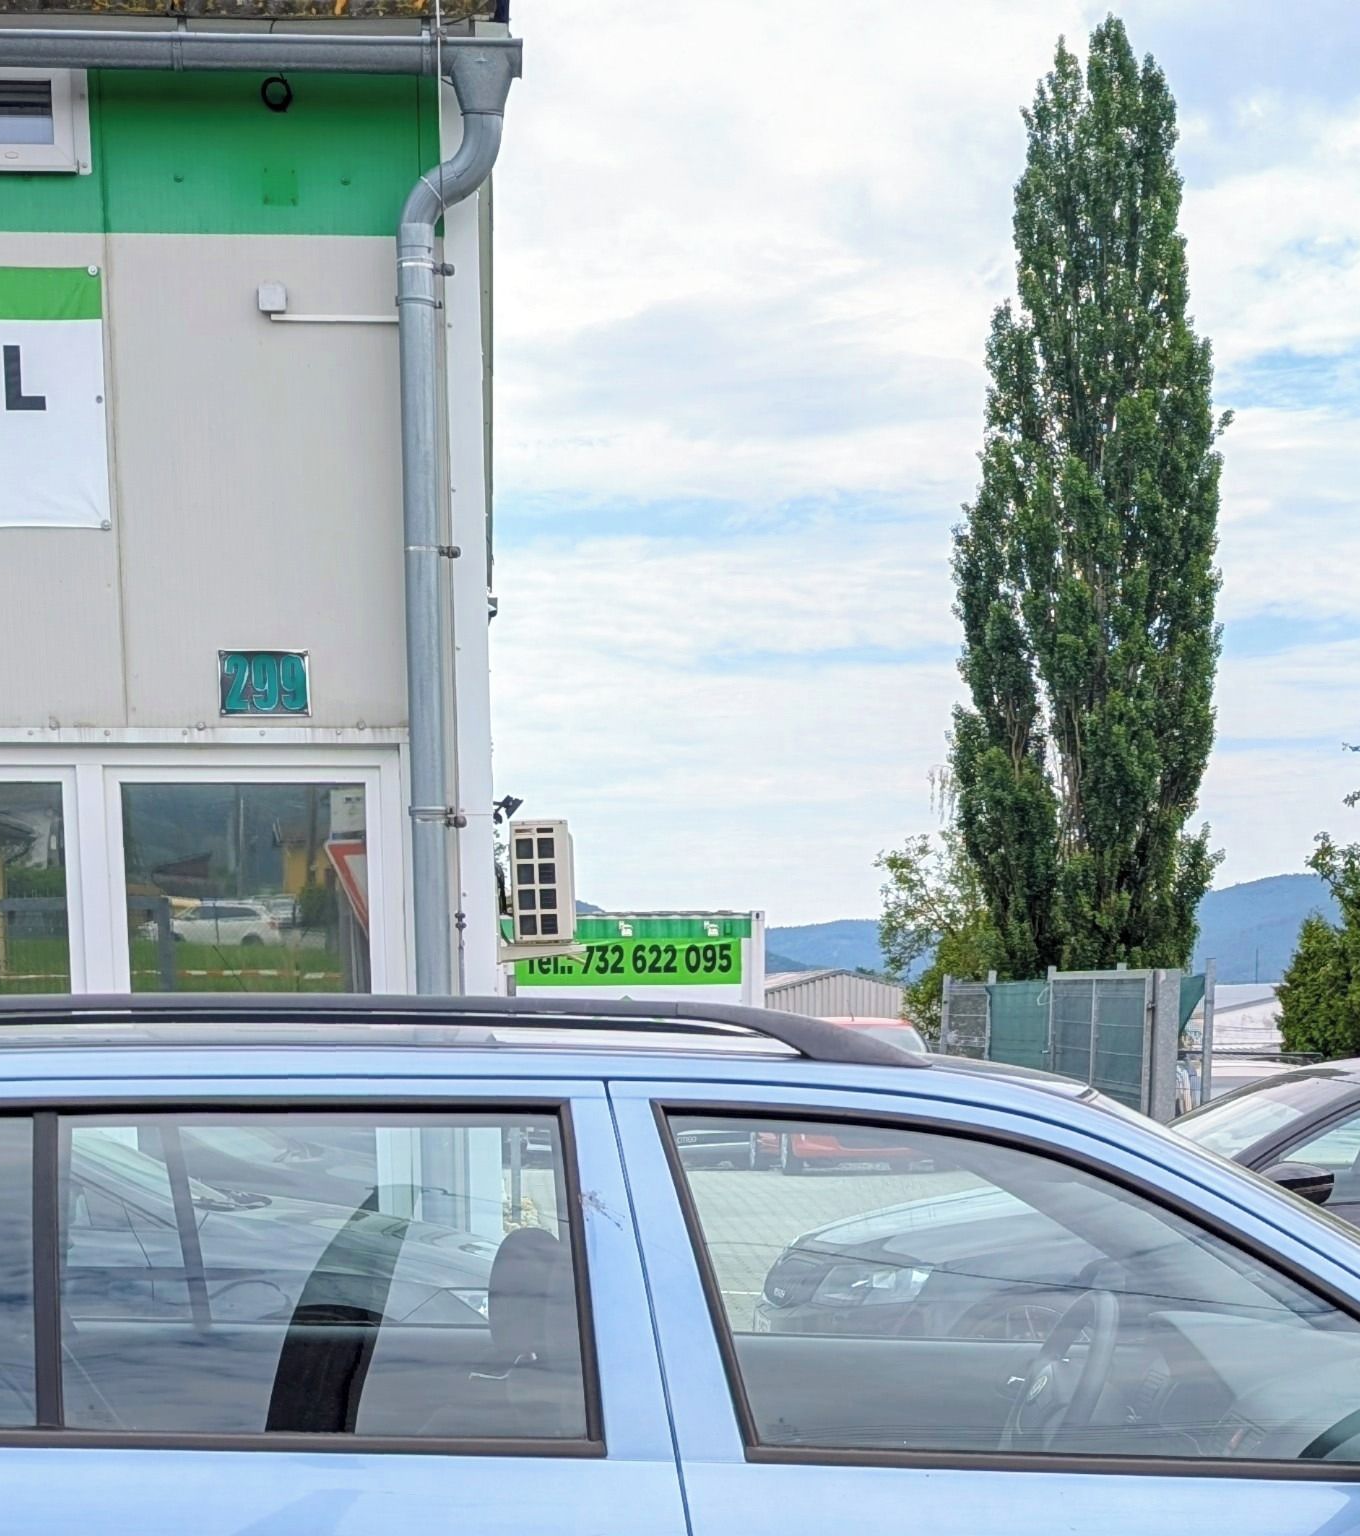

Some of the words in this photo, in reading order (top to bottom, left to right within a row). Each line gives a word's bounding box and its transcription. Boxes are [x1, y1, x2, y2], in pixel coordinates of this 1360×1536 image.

[224, 653, 307, 711] 299
[581, 945, 625, 974] 732
[631, 945, 677, 974] 622
[685, 944, 732, 973] 095
